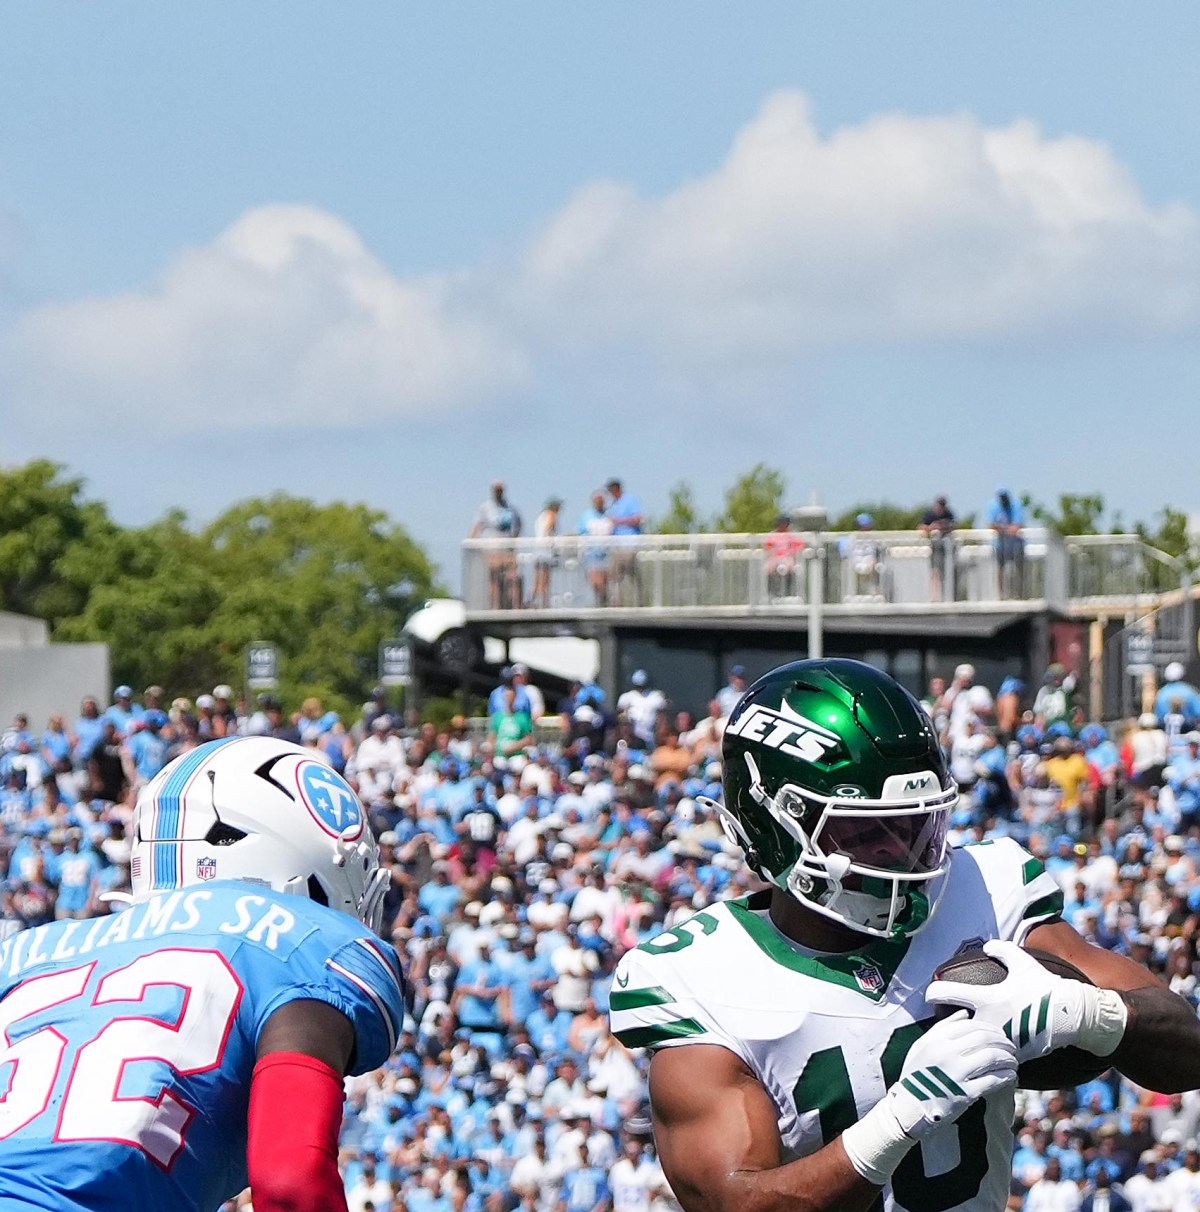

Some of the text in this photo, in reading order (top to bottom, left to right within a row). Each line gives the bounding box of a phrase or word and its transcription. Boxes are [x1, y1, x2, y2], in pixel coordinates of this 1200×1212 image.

[726, 698, 842, 762] JETS
[904, 777, 930, 791] NY
[218, 895, 296, 951] SR
